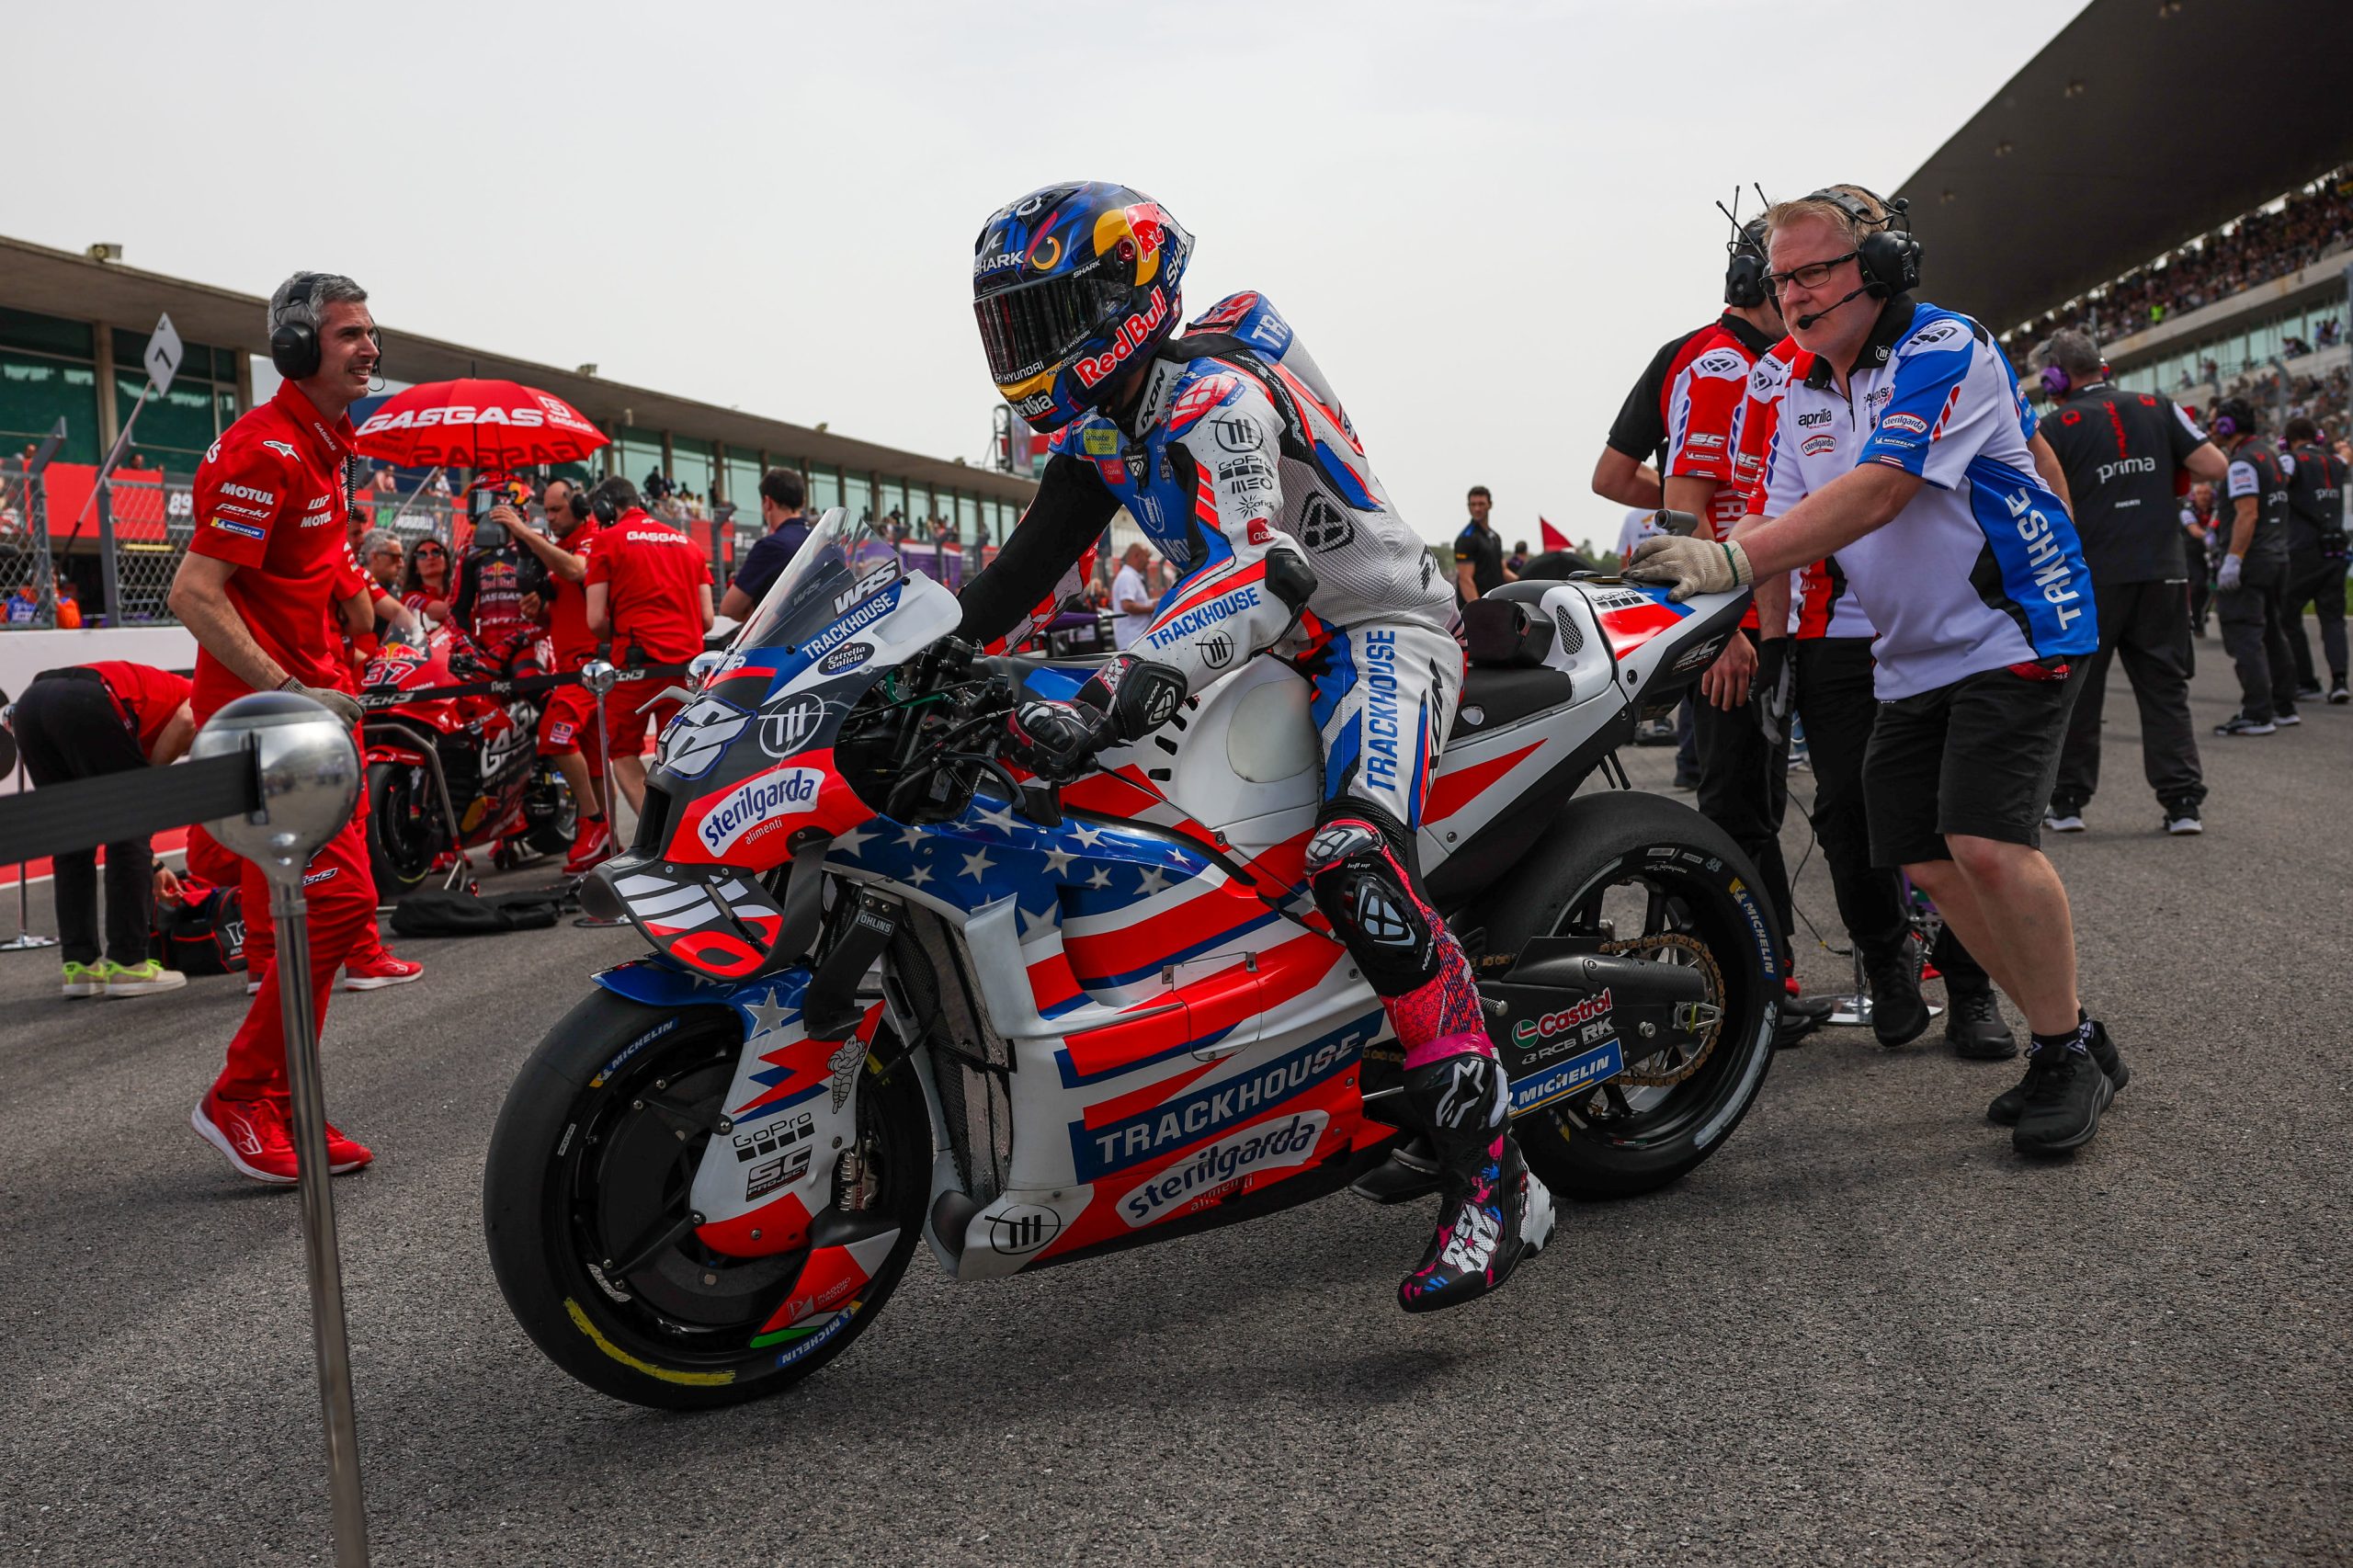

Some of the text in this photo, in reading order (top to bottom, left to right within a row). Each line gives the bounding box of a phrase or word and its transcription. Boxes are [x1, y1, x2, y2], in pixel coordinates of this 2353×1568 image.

[973, 250, 1024, 277] SHARK
[1073, 259, 1101, 278] SHARK
[1073, 325, 1134, 390] Red
[1126, 285, 1168, 347] Bull
[1004, 360, 1045, 383] HYUNDAI
[1140, 367, 1165, 430] IXON
[355, 405, 544, 437] GASGAS
[1798, 408, 1832, 428] aprilia
[1883, 416, 1925, 430] sterilgarda
[1883, 438, 1915, 449] MICHELIN
[2096, 457, 2155, 484] prima
[220, 483, 274, 506] MOTUL
[300, 511, 333, 528] MOTUL
[626, 531, 688, 544] GASGAS
[2005, 487, 2082, 631] TRKHSE
[834, 561, 898, 615] WRS
[1589, 590, 1637, 602] GoPro
[801, 592, 895, 660] TRACKHOUSE
[1146, 586, 1261, 651] TRACKHOUSE
[827, 645, 866, 663] Estrella
[827, 653, 864, 671] Galicia
[361, 659, 416, 687] 37
[1366, 631, 1398, 792] TRACKHOUSE
[705, 769, 814, 847] sterilgarda
[745, 816, 783, 846] alimenti
[860, 912, 893, 934] ÖHLINS
[1742, 902, 1775, 974] MICHELIN
[1539, 987, 1613, 1038] Castrol
[611, 1020, 674, 1069] MICHELIN
[1581, 1017, 1615, 1042] RK
[1539, 1037, 1577, 1060] RCB
[1519, 1055, 1609, 1105] MICHELIN
[1096, 1031, 1361, 1165] TRACKHOUSE
[733, 1111, 812, 1148] GoPro
[747, 1165, 807, 1195] PROJECT
[749, 1150, 811, 1183] SC
[1128, 1115, 1316, 1220] sterilgarda
[817, 1277, 851, 1302] PIAGGIO
[782, 1318, 841, 1364] MICHELIN
